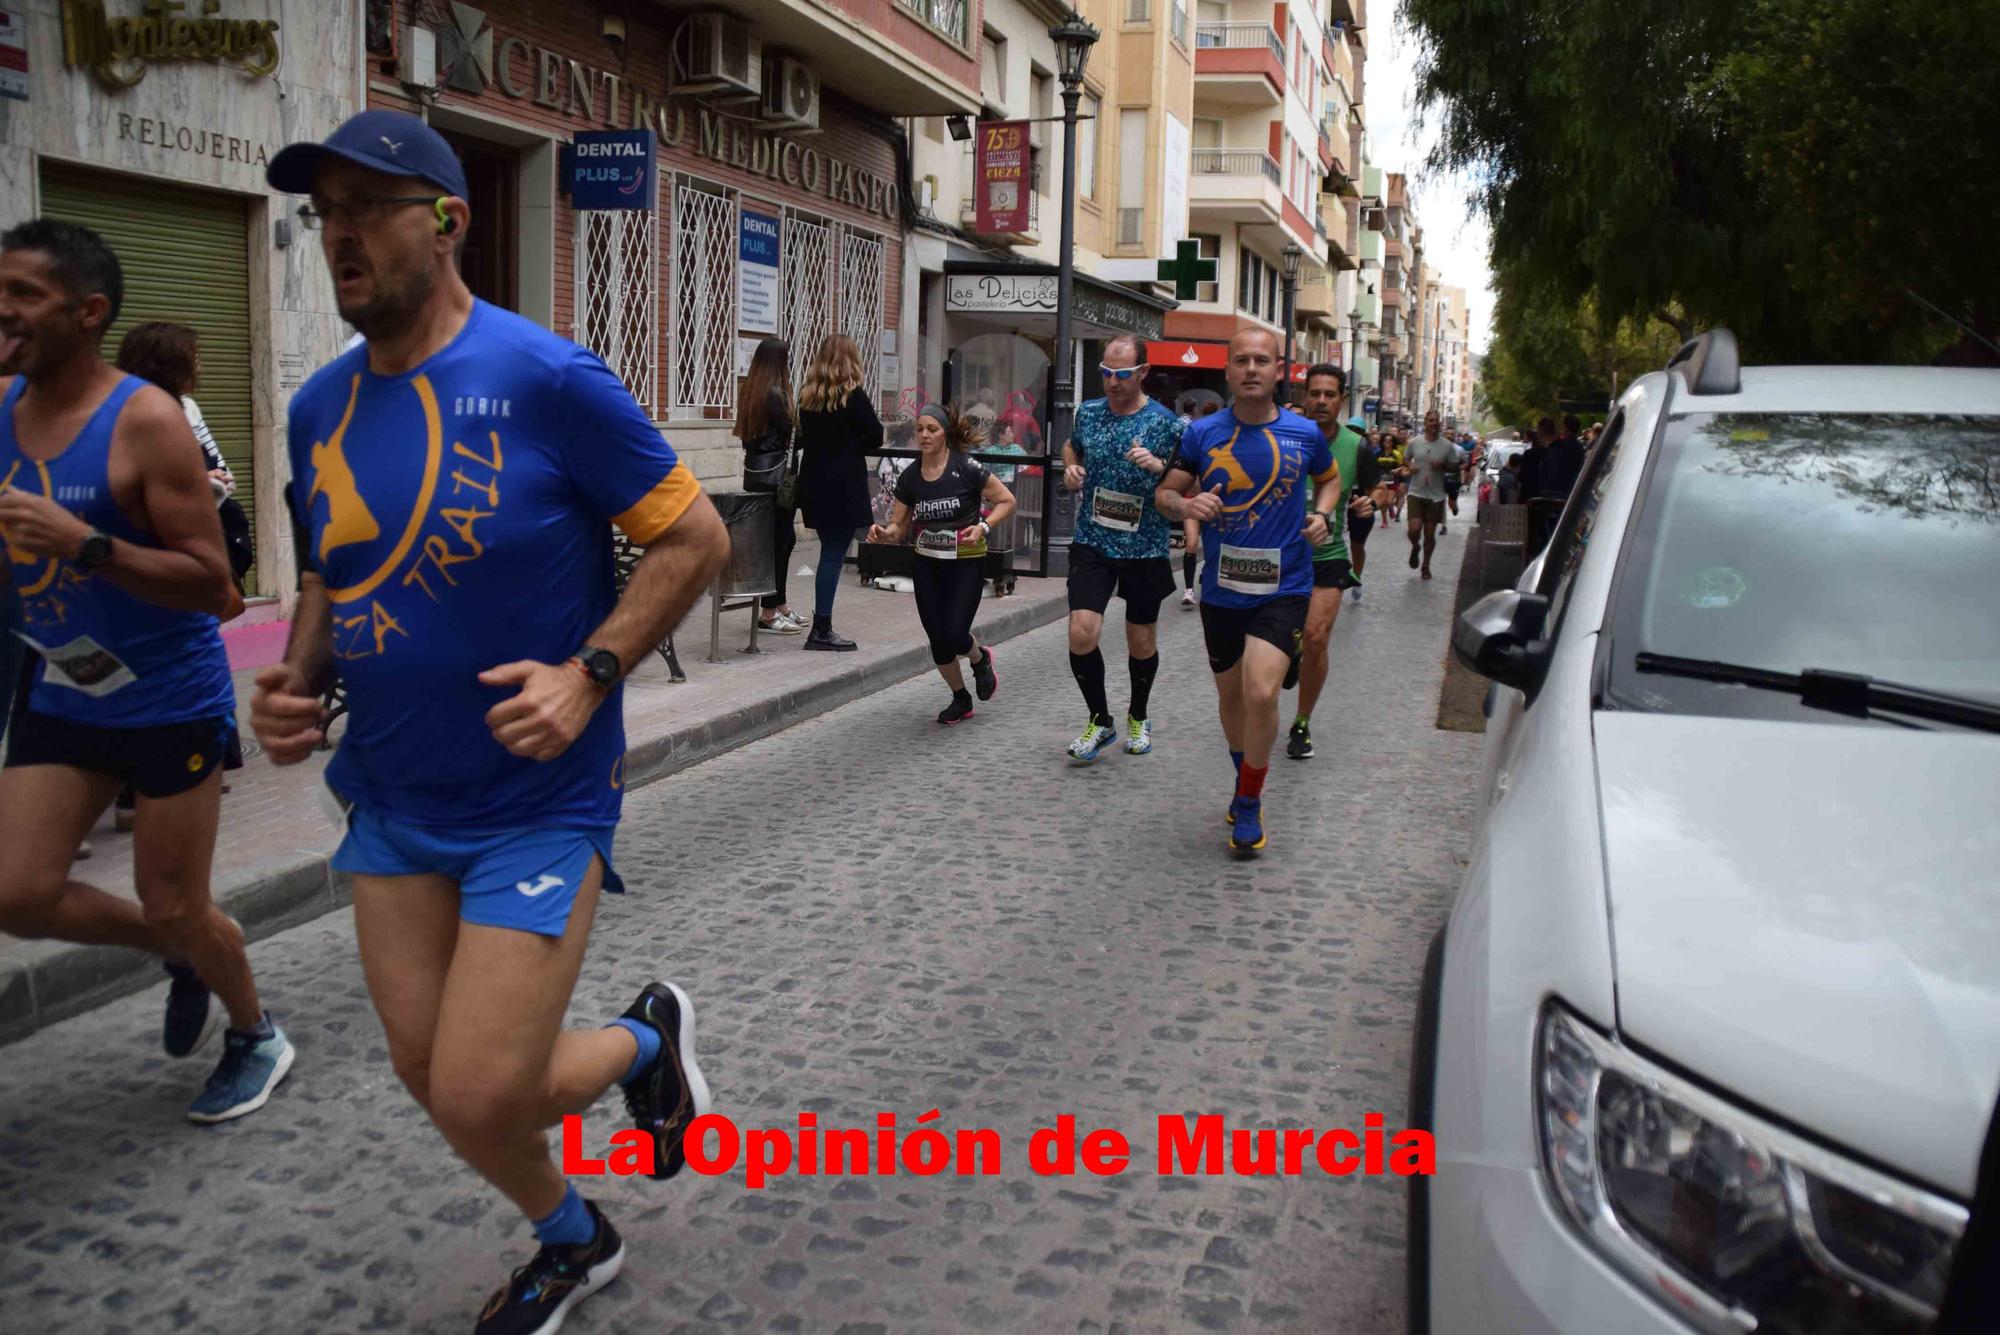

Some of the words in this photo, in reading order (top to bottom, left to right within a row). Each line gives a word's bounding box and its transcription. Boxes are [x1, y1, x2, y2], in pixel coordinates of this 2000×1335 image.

[496, 35, 686, 147] CENTRO
[829, 157, 900, 219] PASEO
[117, 111, 270, 169] RELOJERIA
[576, 142, 647, 157] DENTAL
[987, 127, 1009, 151] 75
[575, 166, 621, 182] PLUS
[743, 216, 778, 238] DENTAL
[743, 237, 767, 255] PLUS
[947, 277, 974, 307] Las
[979, 275, 1058, 300] Delicias
[455, 396, 512, 418] GOBIK
[403, 430, 503, 603] TRAIL
[1225, 557, 1273, 575] 1084
